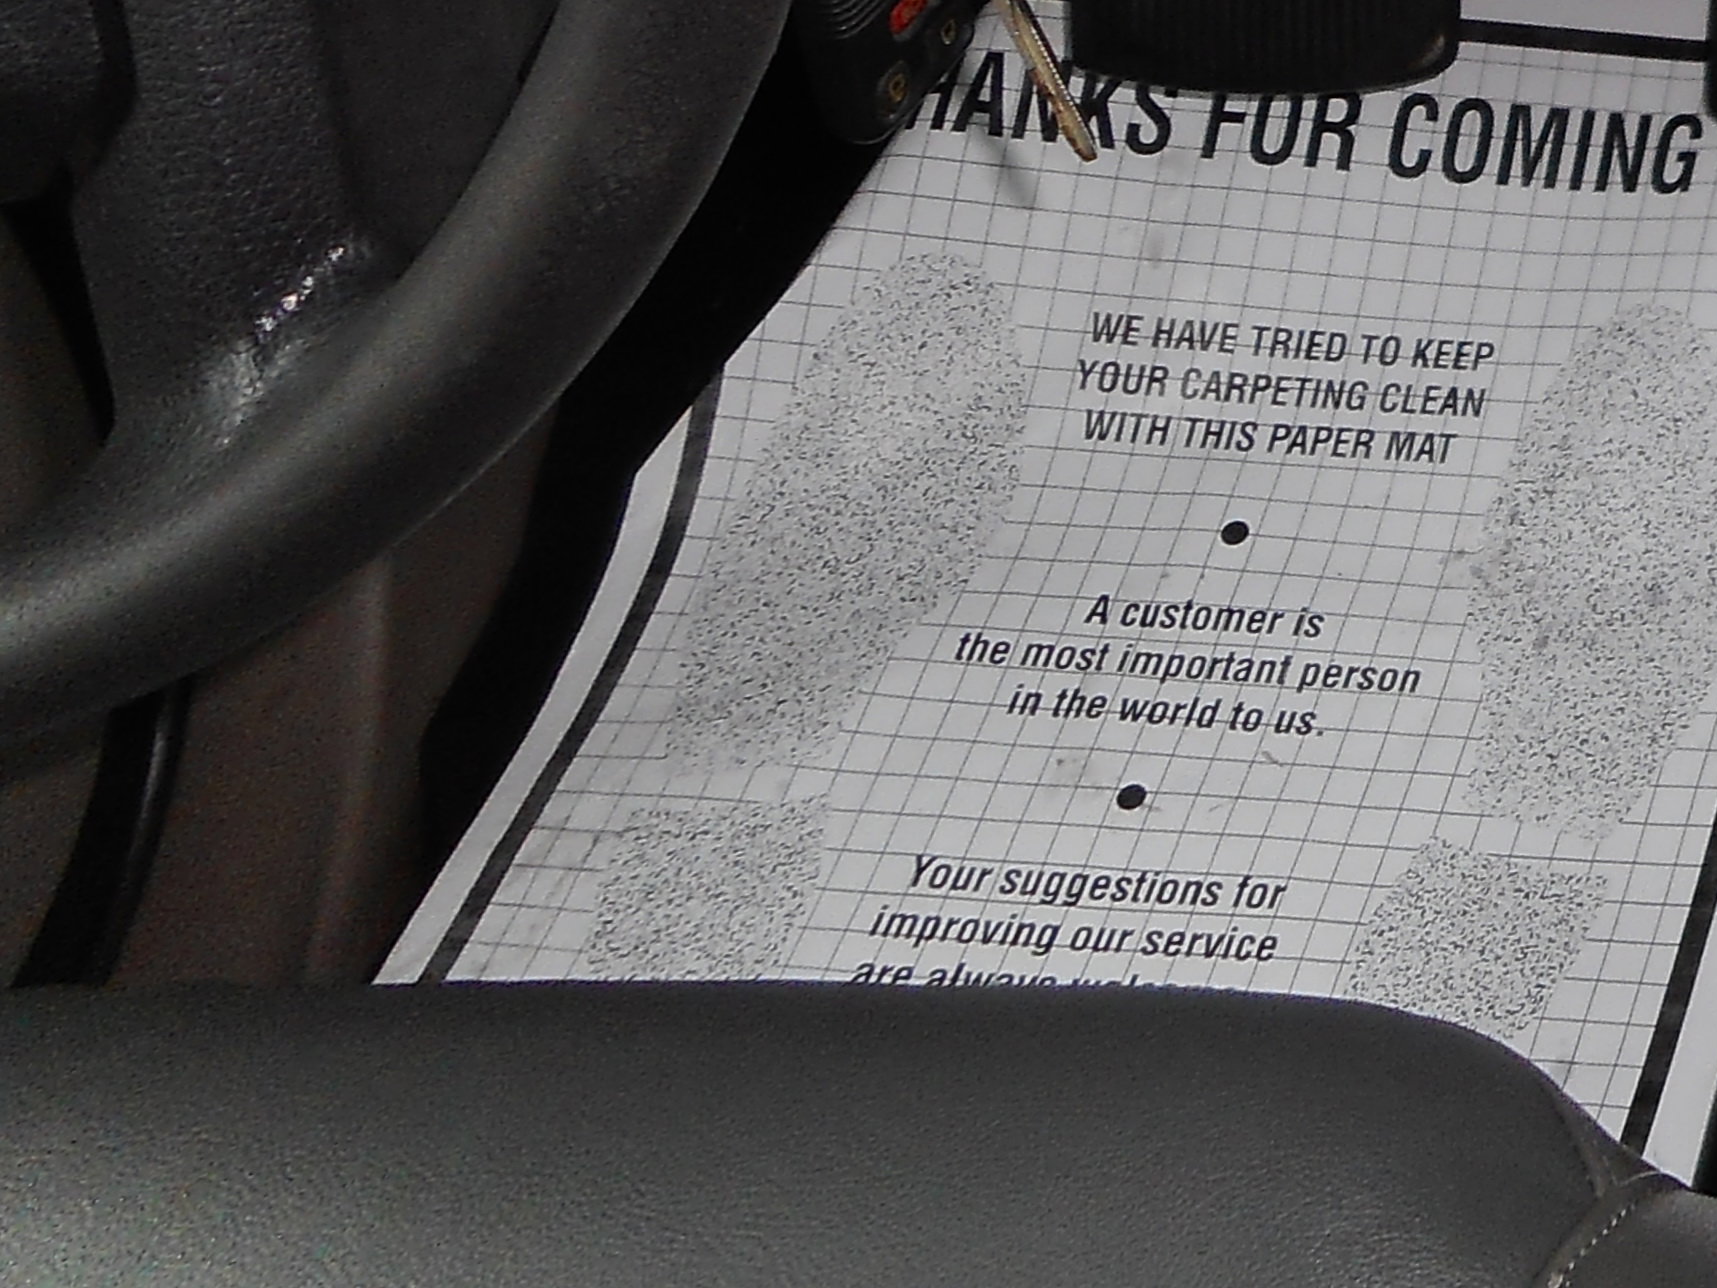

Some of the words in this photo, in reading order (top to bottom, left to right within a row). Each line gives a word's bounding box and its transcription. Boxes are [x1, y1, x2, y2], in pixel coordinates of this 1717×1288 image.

[1201, 92, 1362, 171] FOR
[1388, 92, 1704, 194] COMING
[1090, 311, 1144, 346] WE
[1151, 317, 1239, 354] HAVE
[1250, 325, 1348, 362] TRIED
[1360, 333, 1401, 366] TO
[1410, 338, 1495, 371] KEEP
[1076, 358, 1169, 398] YOUR
[1180, 367, 1369, 411] CARPETING
[1379, 384, 1487, 417] CLEAN
[1082, 409, 1171, 447] WITH
[1182, 417, 1258, 452] THIS
[1266, 423, 1374, 460] PAPER
[1383, 431, 1457, 465] MAT
[1084, 594, 1111, 626] A
[1121, 600, 1285, 636] customer
[1292, 607, 1325, 639] is
[953, 632, 1011, 665] the
[1020, 641, 1109, 672] most
[1115, 643, 1293, 685] important
[1296, 666, 1421, 694] person
[1006, 684, 1038, 716] in
[1051, 687, 1108, 719] the
[1119, 697, 1222, 730] world
[1230, 703, 1265, 733] to
[1274, 709, 1325, 738] us.
[910, 854, 994, 893] Your
[1000, 865, 1223, 908] suggestions
[1232, 873, 1287, 910] for
[869, 905, 1061, 956] improving
[1070, 925, 1135, 954] our
[1140, 926, 1279, 963] service
[852, 960, 914, 986] are
